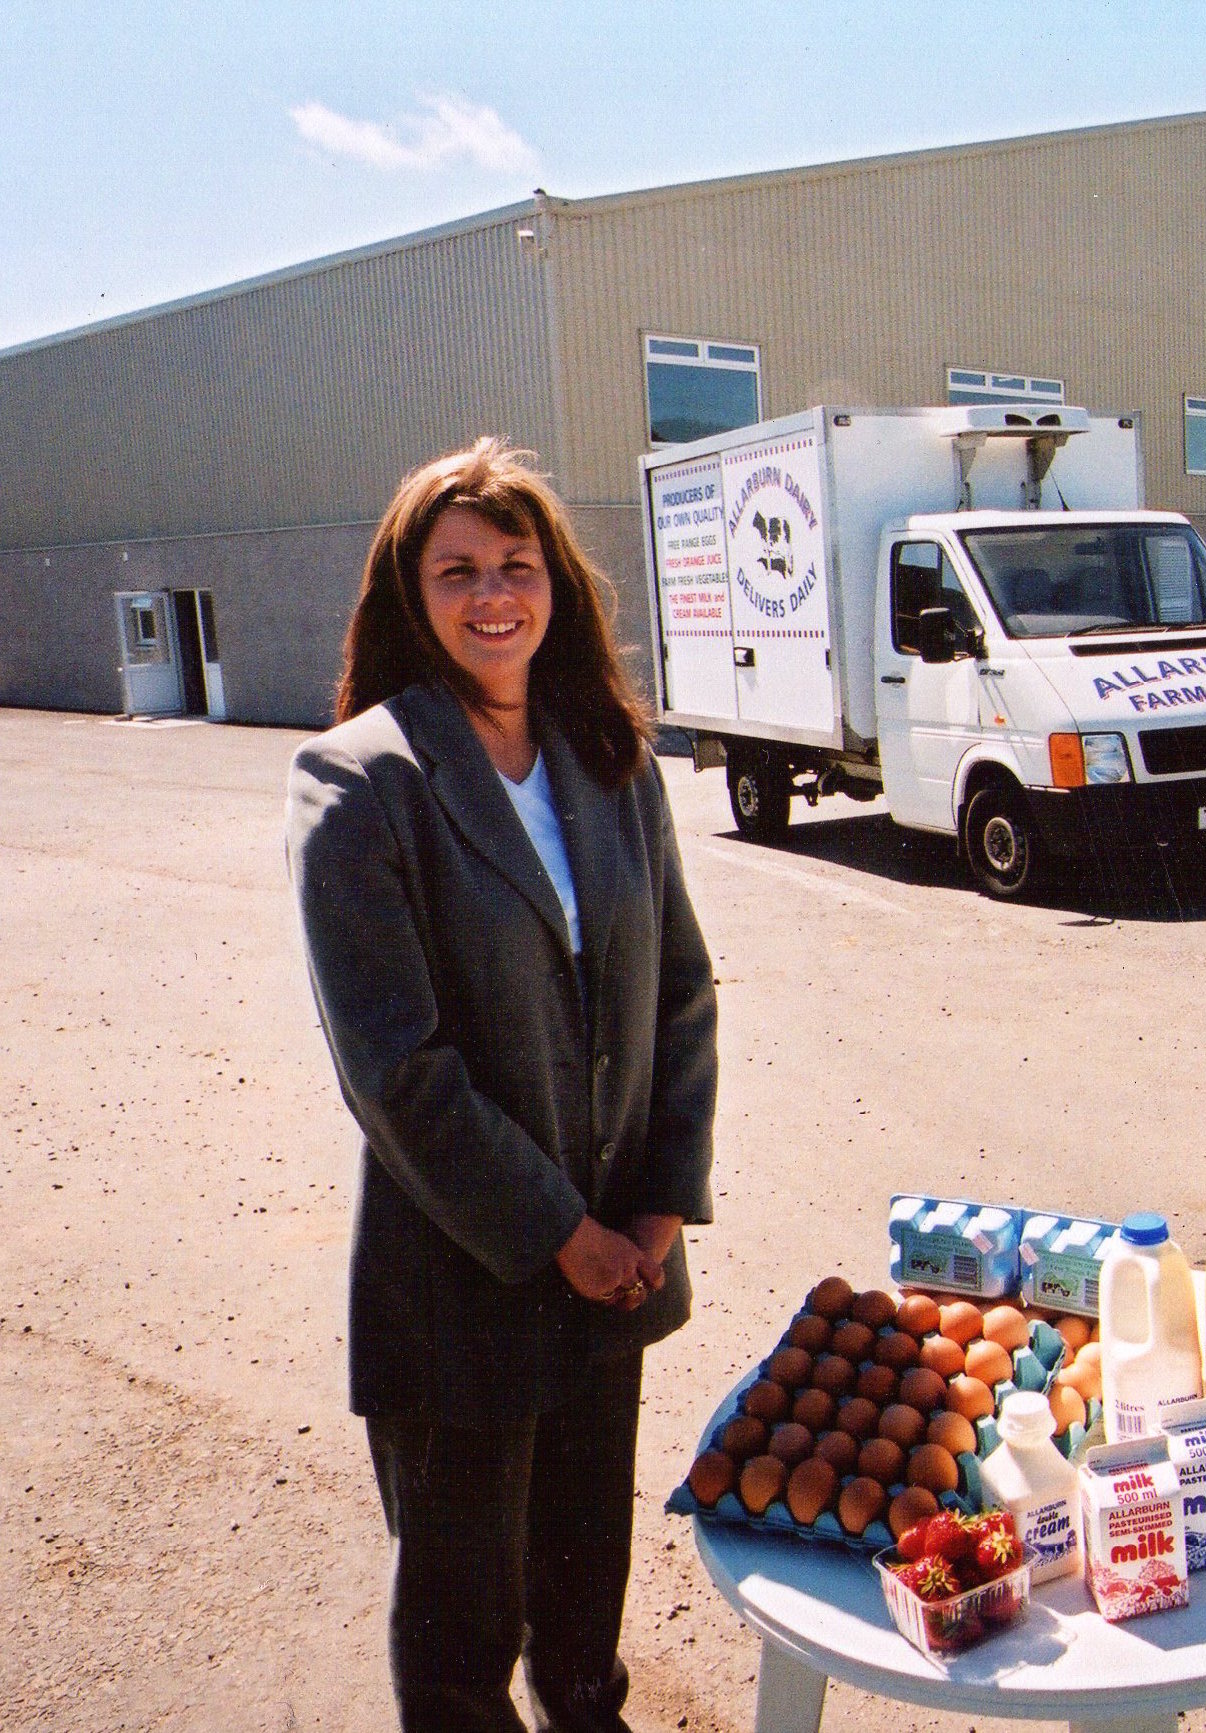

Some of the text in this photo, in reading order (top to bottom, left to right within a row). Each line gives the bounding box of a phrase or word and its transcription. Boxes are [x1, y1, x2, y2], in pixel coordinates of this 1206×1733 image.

[662, 484, 715, 507] PRODUCERS OF
[729, 466, 818, 538] ALLARBURN DAIRY
[657, 506, 724, 529] OUR OWN QUALITY
[668, 535, 717, 550] FREE RANGE EGGS
[666, 553, 722, 568] FRESH ORANGE JUICE
[678, 575, 694, 586] FRESH
[736, 562, 817, 618] DELIVERS DAILY
[669, 593, 679, 604] THE
[680, 592, 697, 604] FINEST
[698, 592, 712, 603] MILK
[673, 607, 722, 619] CREAM AVAILABLE
[1113, 1473, 1154, 1493] milk
[1117, 1488, 1158, 1505] 500 ml
[1026, 1499, 1067, 1518] ALLARBURN
[1037, 1511, 1059, 1524] double
[1108, 1501, 1171, 1520] ALLARBURN
[1025, 1516, 1070, 1542] cream
[1109, 1511, 1172, 1529] PASTEURISED
[1109, 1519, 1173, 1538] SEMI-SKIMMED
[1111, 1530, 1175, 1564] milk
